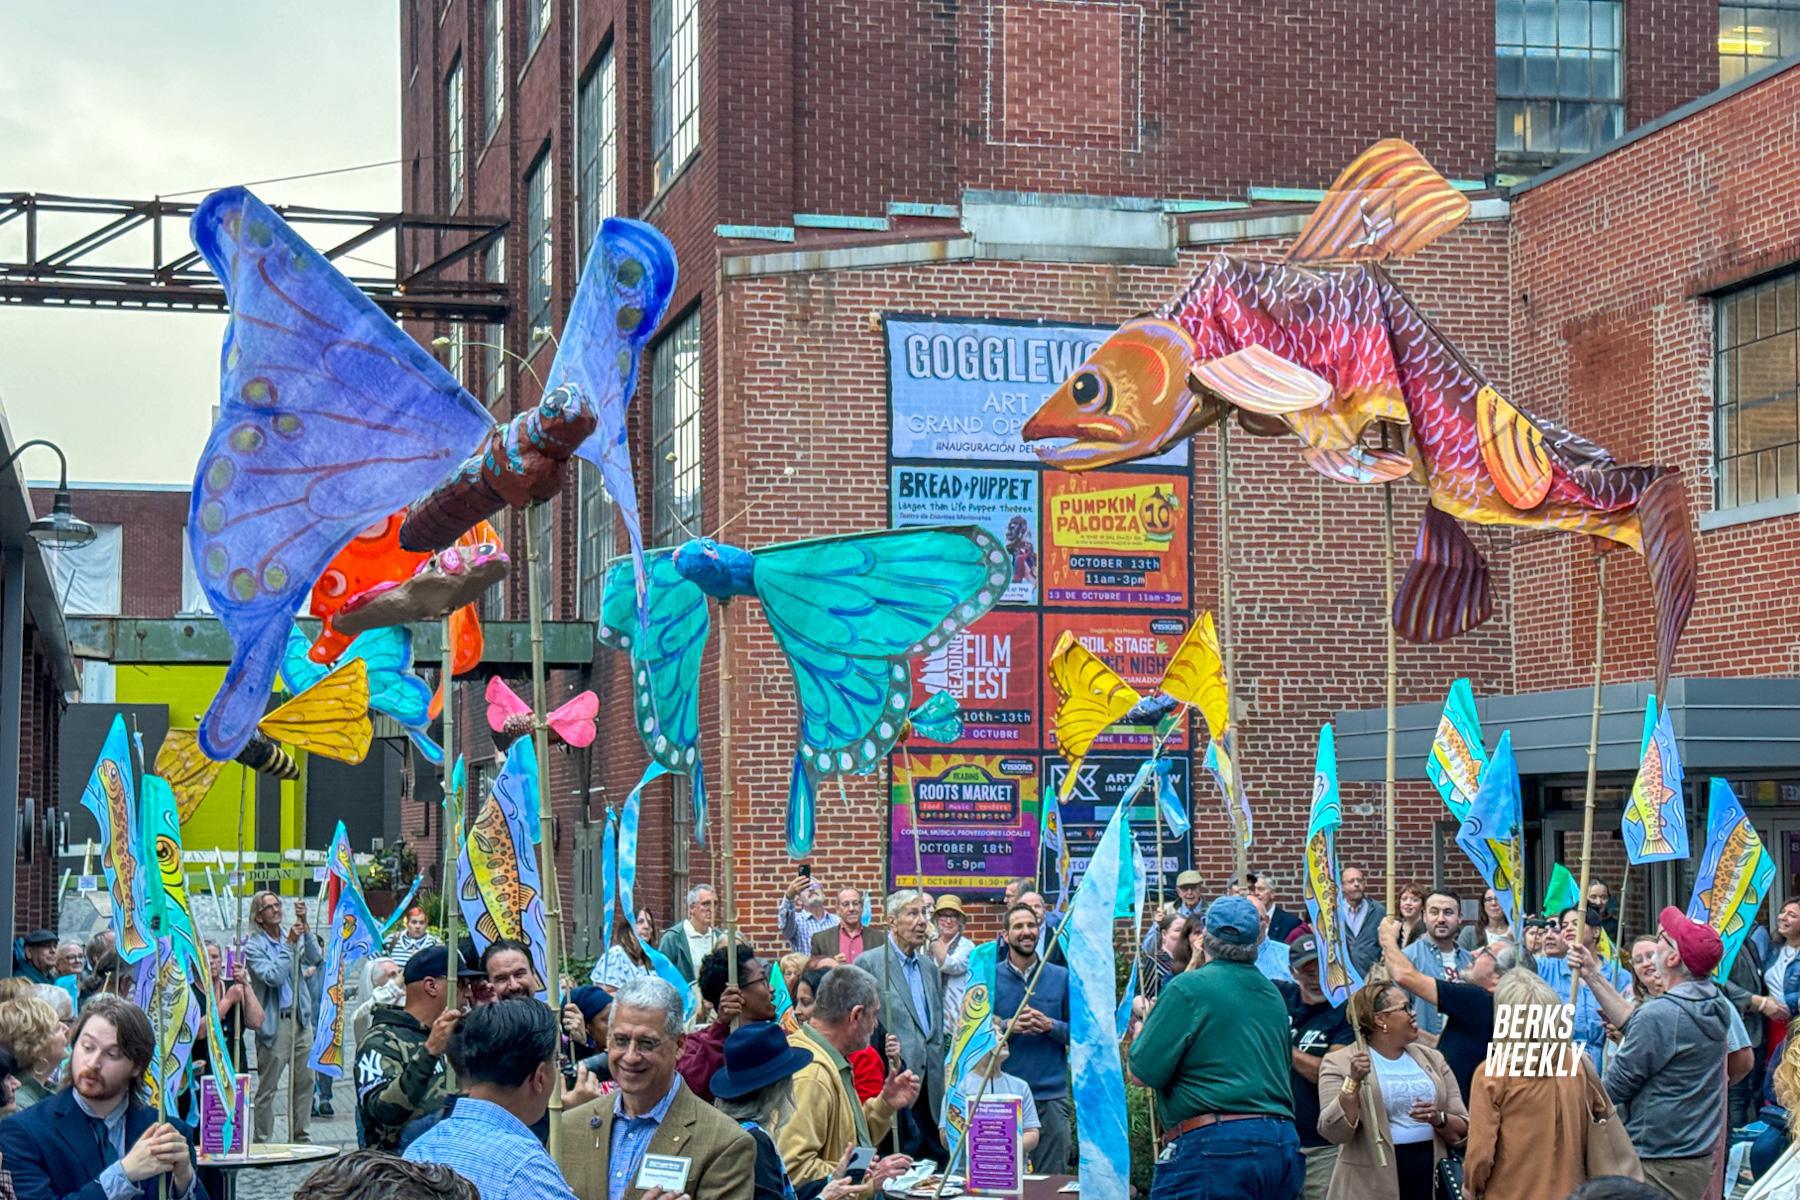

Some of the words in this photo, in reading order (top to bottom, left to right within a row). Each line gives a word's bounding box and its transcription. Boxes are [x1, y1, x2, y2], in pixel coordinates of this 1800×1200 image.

[982, 392, 1030, 415] ART
[908, 416, 983, 435] GRAND
[1019, 445, 1036, 453] DEL
[900, 472, 961, 498] BREAD
[970, 477, 1032, 500] PUPPET
[951, 502, 966, 511] Life
[1060, 494, 1136, 515] PUMPKIN
[1057, 515, 1140, 533] PALOOZA
[1070, 557, 1123, 569] OCTOBER
[1131, 559, 1160, 569] 13th
[1086, 574, 1146, 585] 11am-3pm
[1049, 591, 1060, 599] 13
[1082, 592, 1121, 600] OCTUBRE
[1138, 593, 1182, 602] 11am-3pm
[1080, 636, 1109, 653] SOIL
[1114, 637, 1155, 653] STAGE
[963, 635, 1011, 667] FILM
[950, 634, 963, 698] READING
[963, 668, 1011, 699] FEST
[963, 712, 1031, 722] 10th-13th
[973, 730, 1019, 739] OCTUBRE
[1105, 774, 1135, 783] ART
[919, 784, 959, 800] ROOTS
[962, 785, 1012, 801] MARKET
[920, 843, 974, 854] OCTOBER
[982, 844, 1012, 854] 18th
[947, 860, 986, 872] 5-9pm
[250, 869, 292, 881] DOLAN
